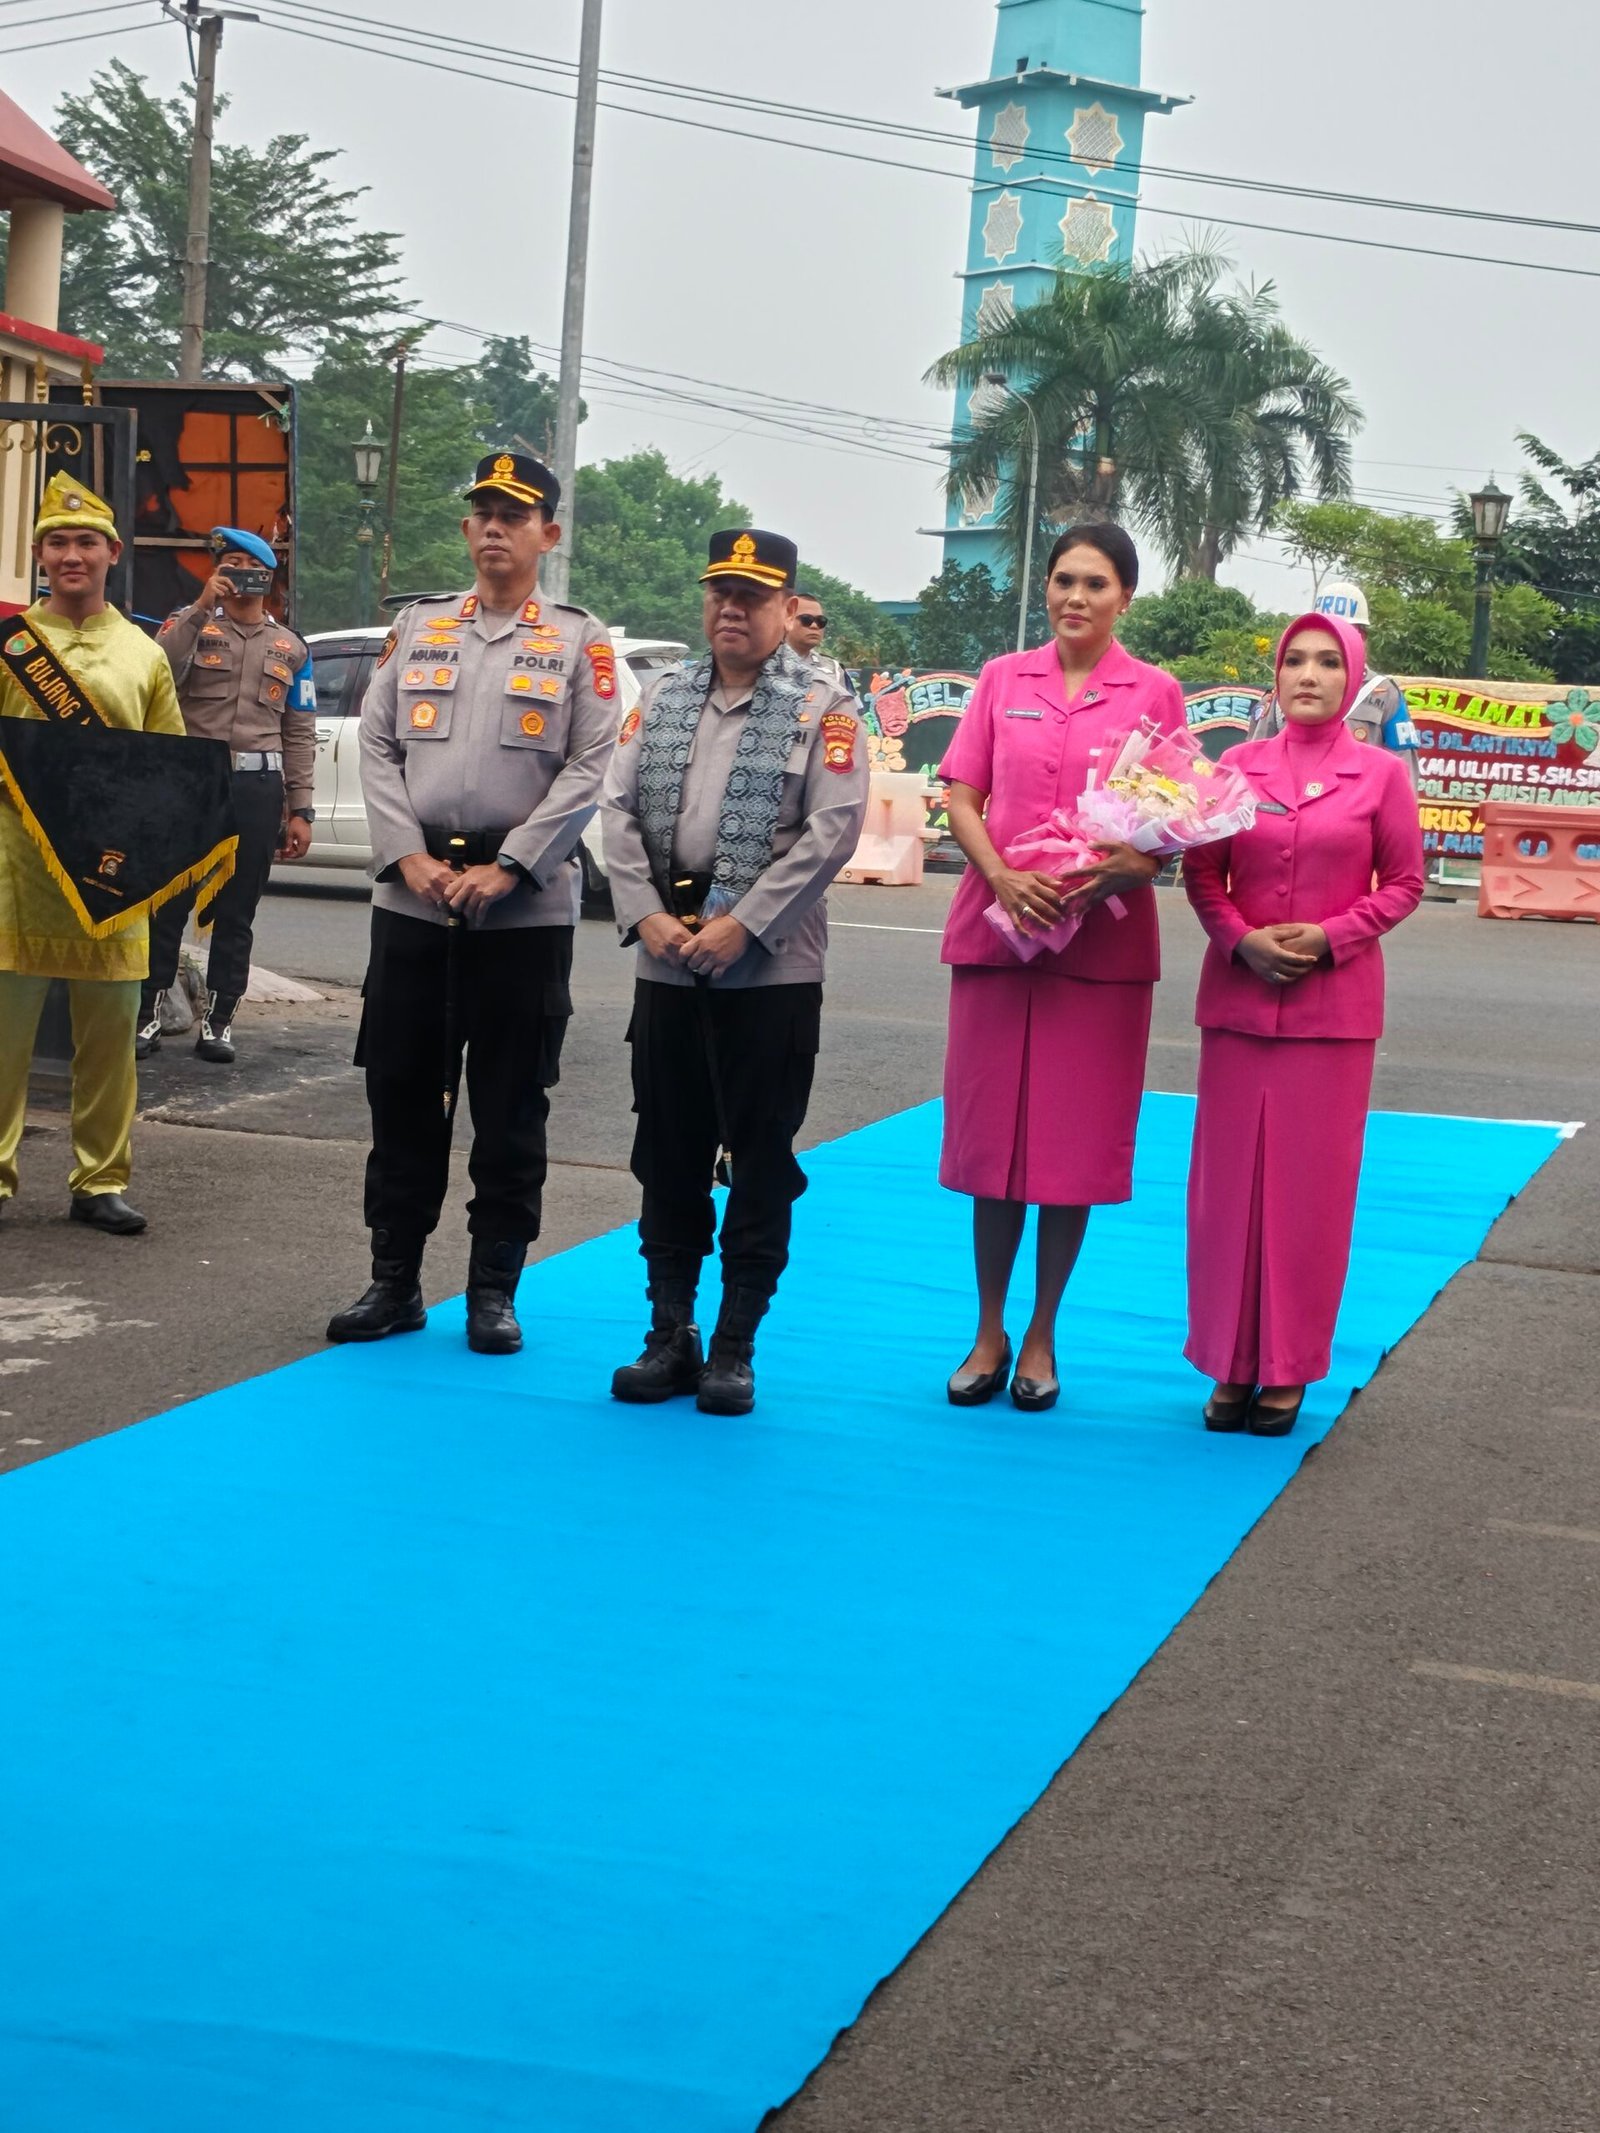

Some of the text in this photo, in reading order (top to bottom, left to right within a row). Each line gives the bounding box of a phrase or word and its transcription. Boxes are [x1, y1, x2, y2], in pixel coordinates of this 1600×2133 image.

[409, 649, 459, 662] AGUNG A
[513, 655, 564, 672] POLRI
[24, 656, 81, 719] BUJANG
[1403, 687, 1548, 728] SELAMAT
[1417, 778, 1487, 800] POLRES
